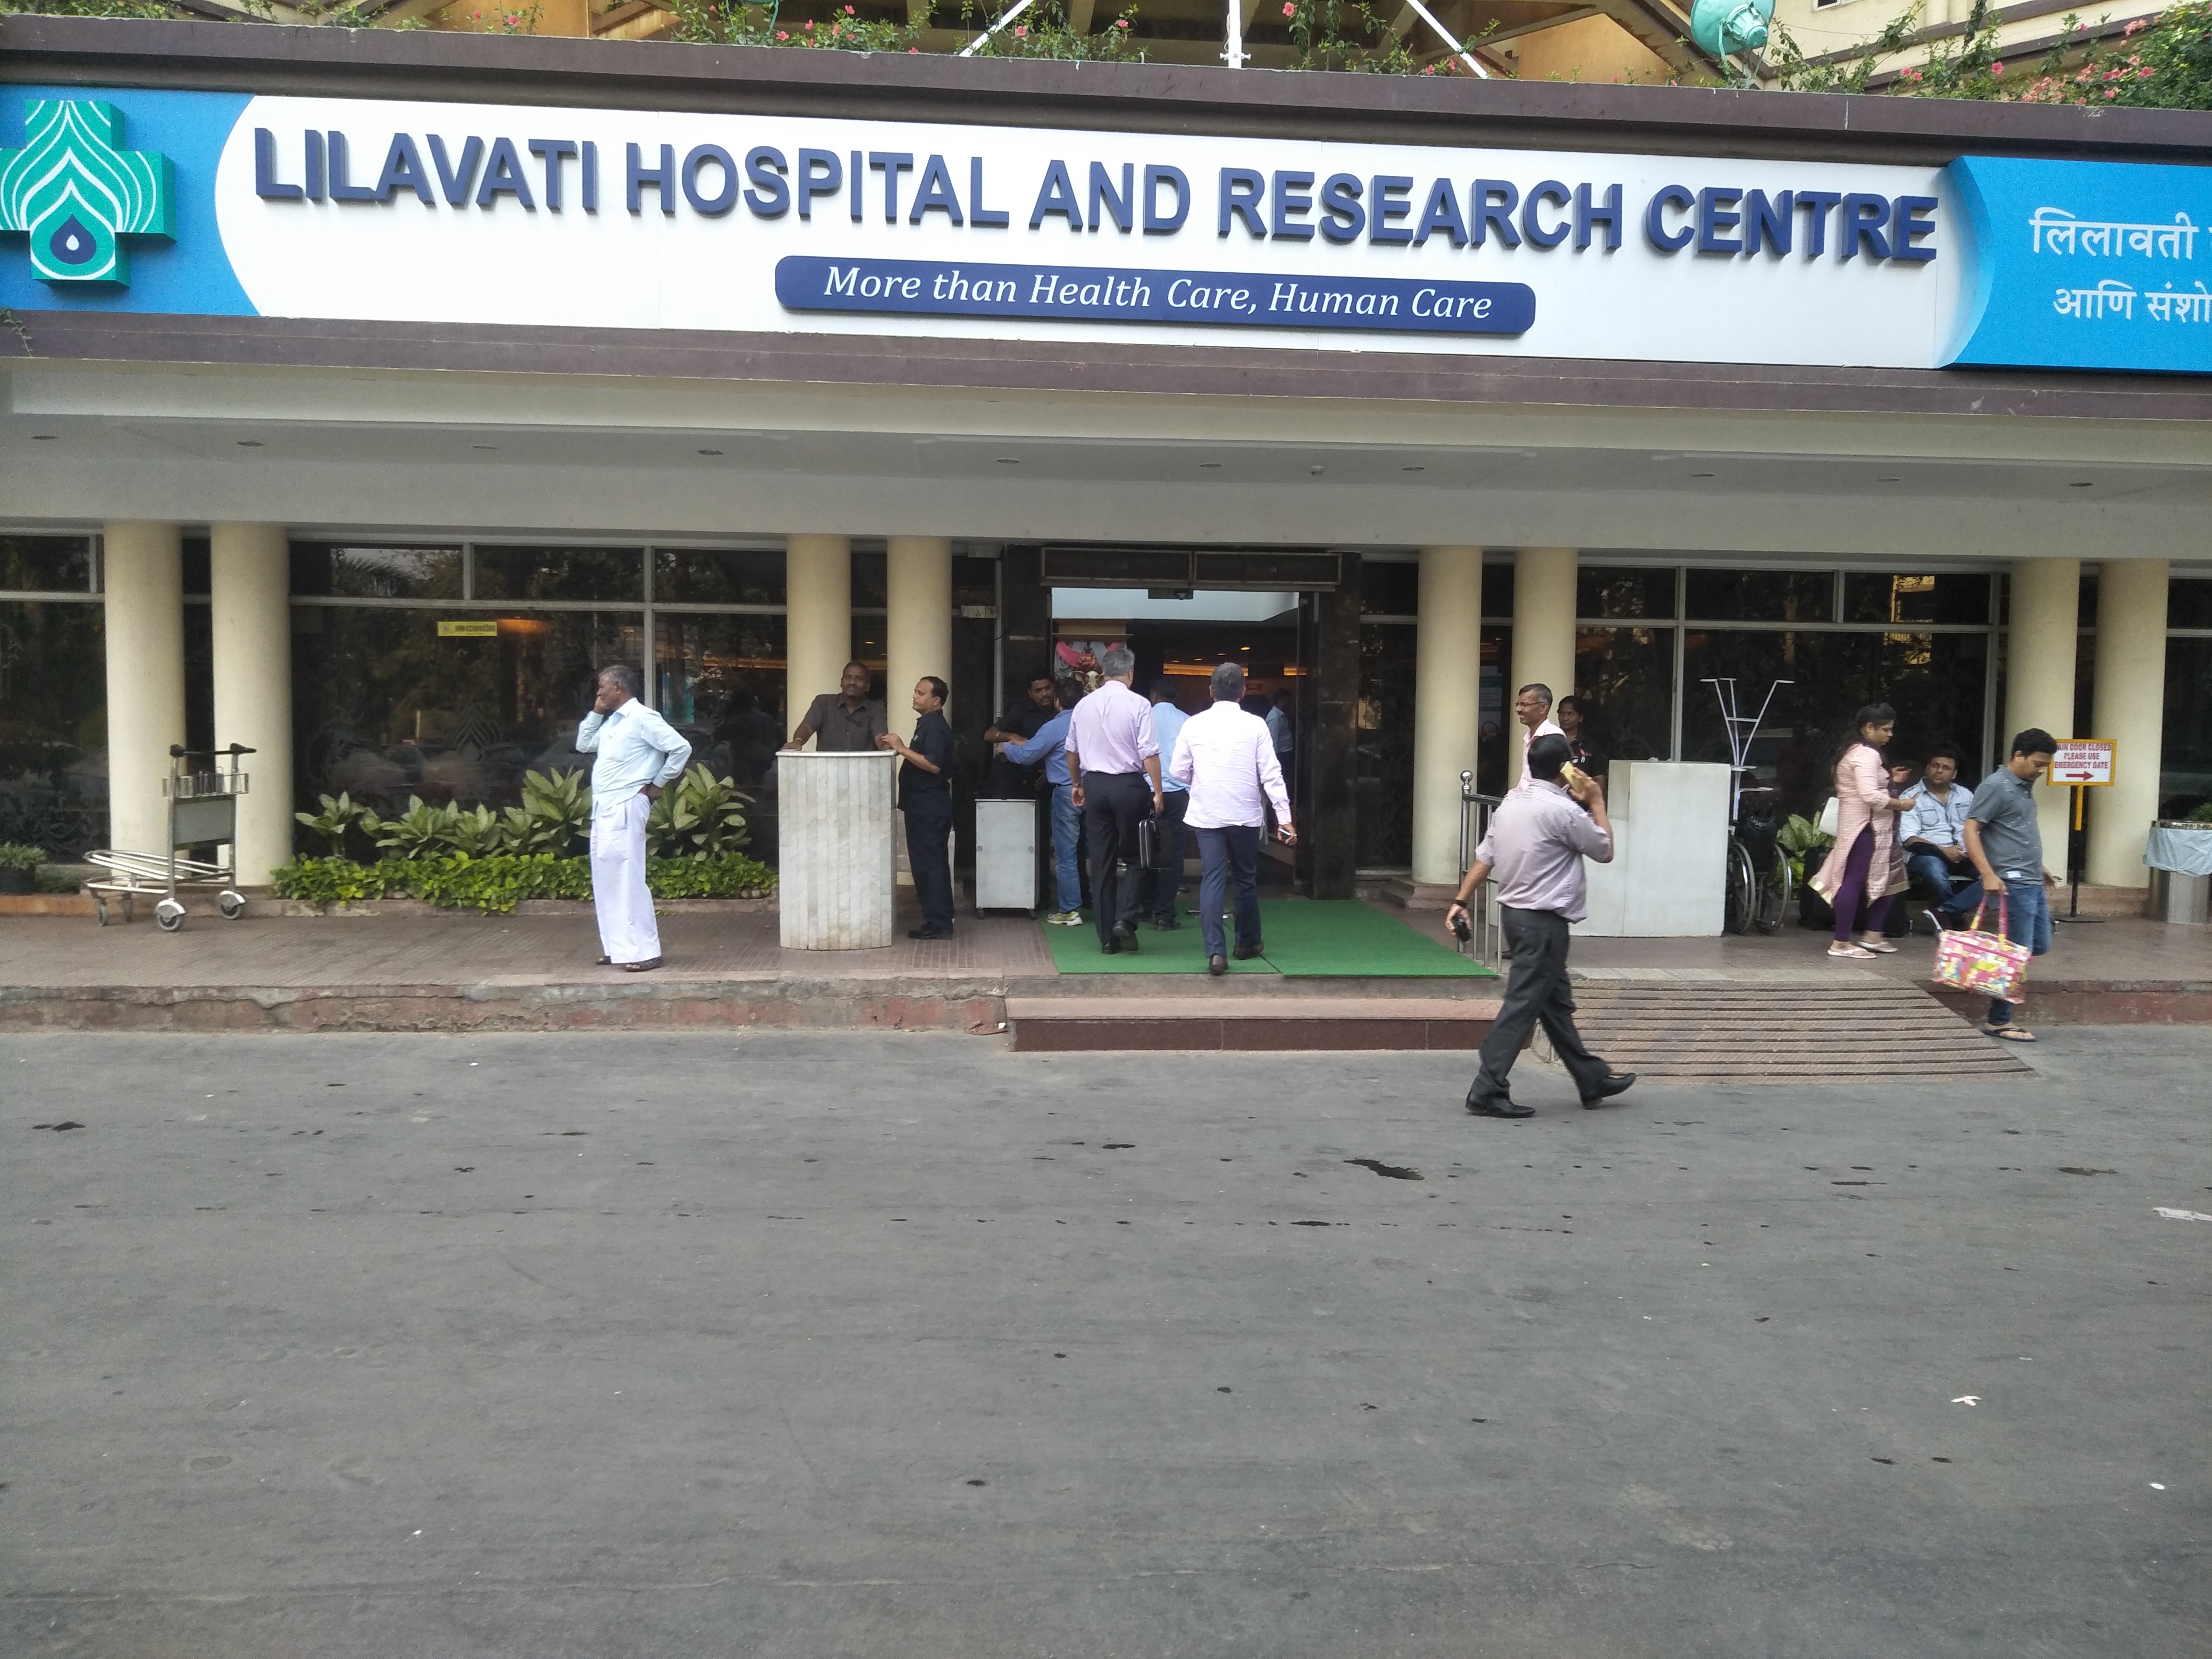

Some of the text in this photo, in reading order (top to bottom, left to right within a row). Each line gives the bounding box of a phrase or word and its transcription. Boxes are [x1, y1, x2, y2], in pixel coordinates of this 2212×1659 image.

[255, 128, 1939, 263] LILAVATI HOSPITAL AND RESEARCH CENTRE
[2028, 206, 2200, 259] लिलावती
[824, 266, 1492, 319] More than Health Care, Human Care
[2053, 279, 2138, 320] आणि
